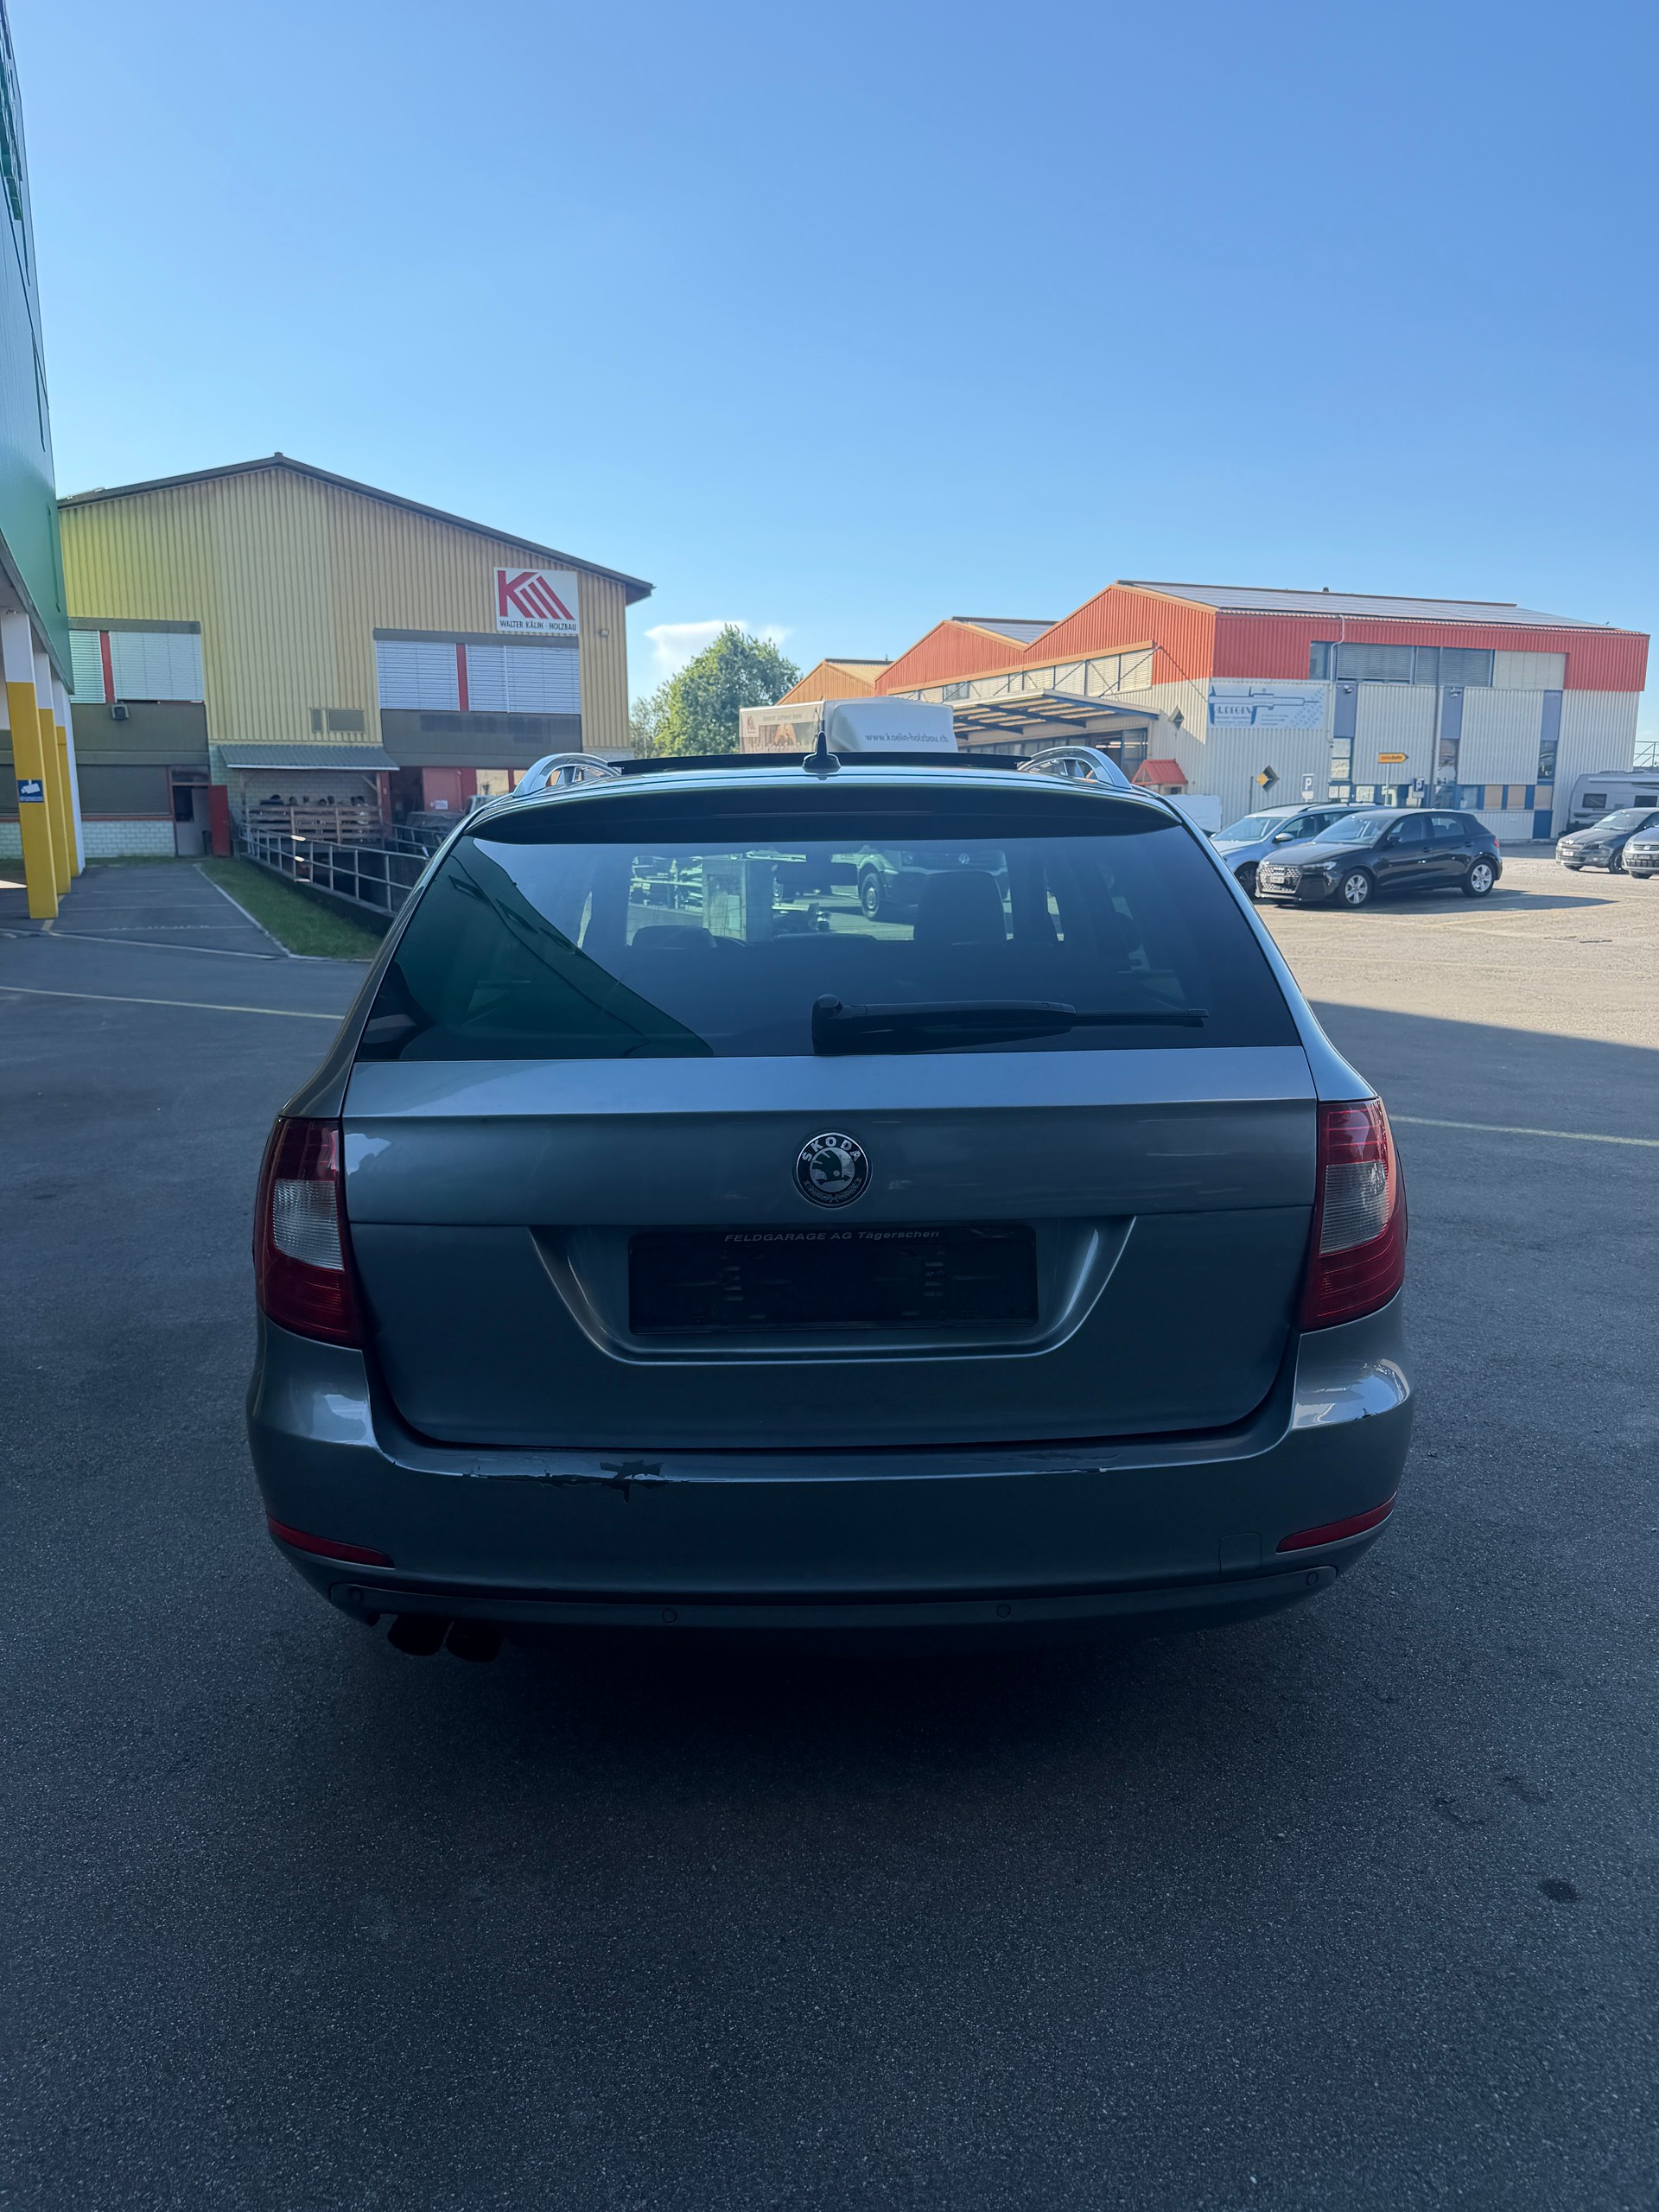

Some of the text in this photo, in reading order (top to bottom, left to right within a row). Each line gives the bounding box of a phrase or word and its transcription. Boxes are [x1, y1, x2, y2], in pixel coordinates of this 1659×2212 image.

[499, 620, 524, 629] WALTER
[525, 620, 544, 630] KÄLIN
[549, 622, 577, 632] HOLZBAU
[1305, 777, 1313, 791] P
[1415, 780, 1424, 793] P
[724, 1230, 940, 1243] FELDGARAGE AG Tägerschen
